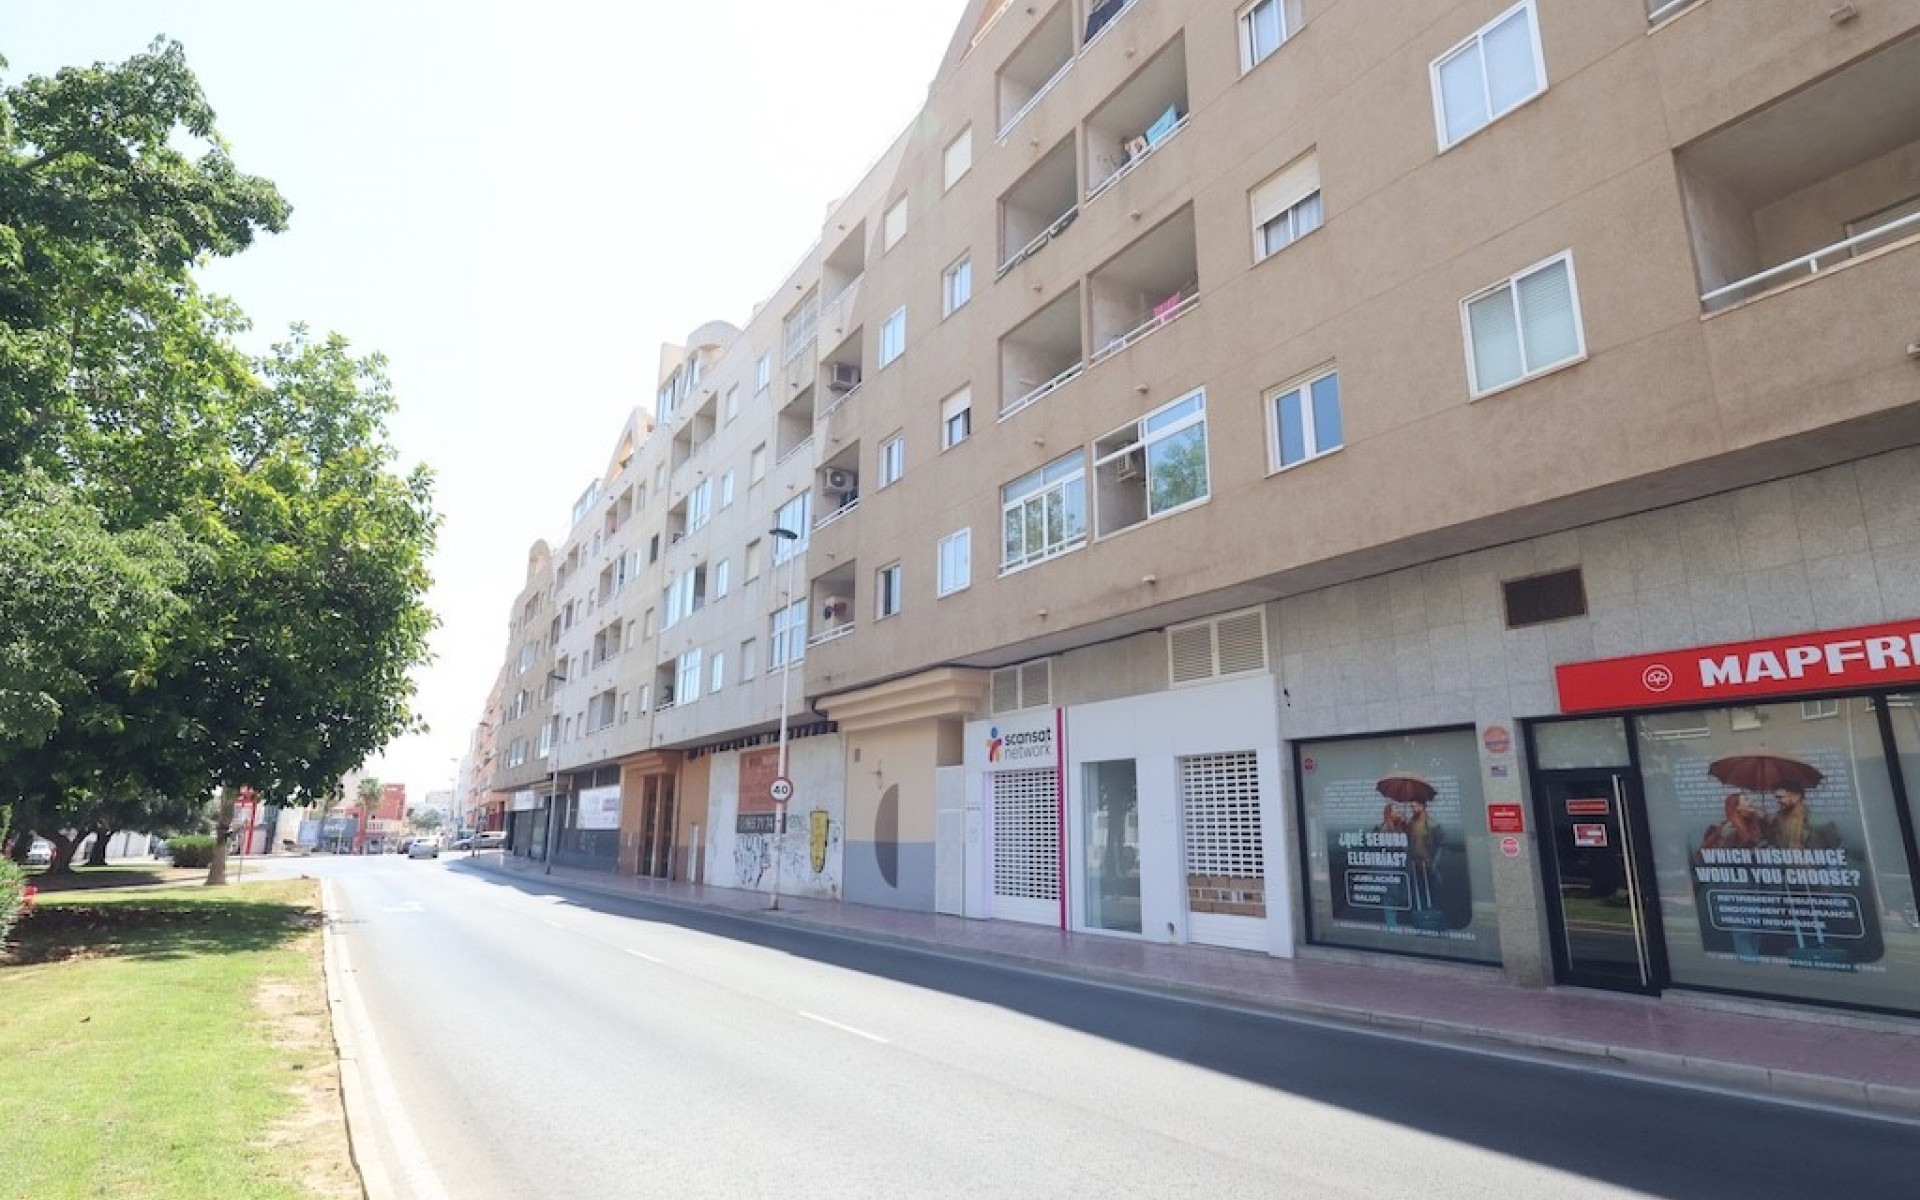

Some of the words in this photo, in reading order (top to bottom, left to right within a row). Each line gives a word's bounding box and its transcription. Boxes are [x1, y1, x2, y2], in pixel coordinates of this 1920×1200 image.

[1005, 727, 1051, 746] scansat
[1005, 744, 1051, 760] network
[773, 785, 788, 795] 40
[1700, 847, 1751, 864] WHICH
[1755, 848, 1847, 866] INSURANCE
[1695, 866, 1749, 883] WOULD
[1750, 868, 1782, 885] YOU
[1785, 868, 1861, 887] CHOOSE?
